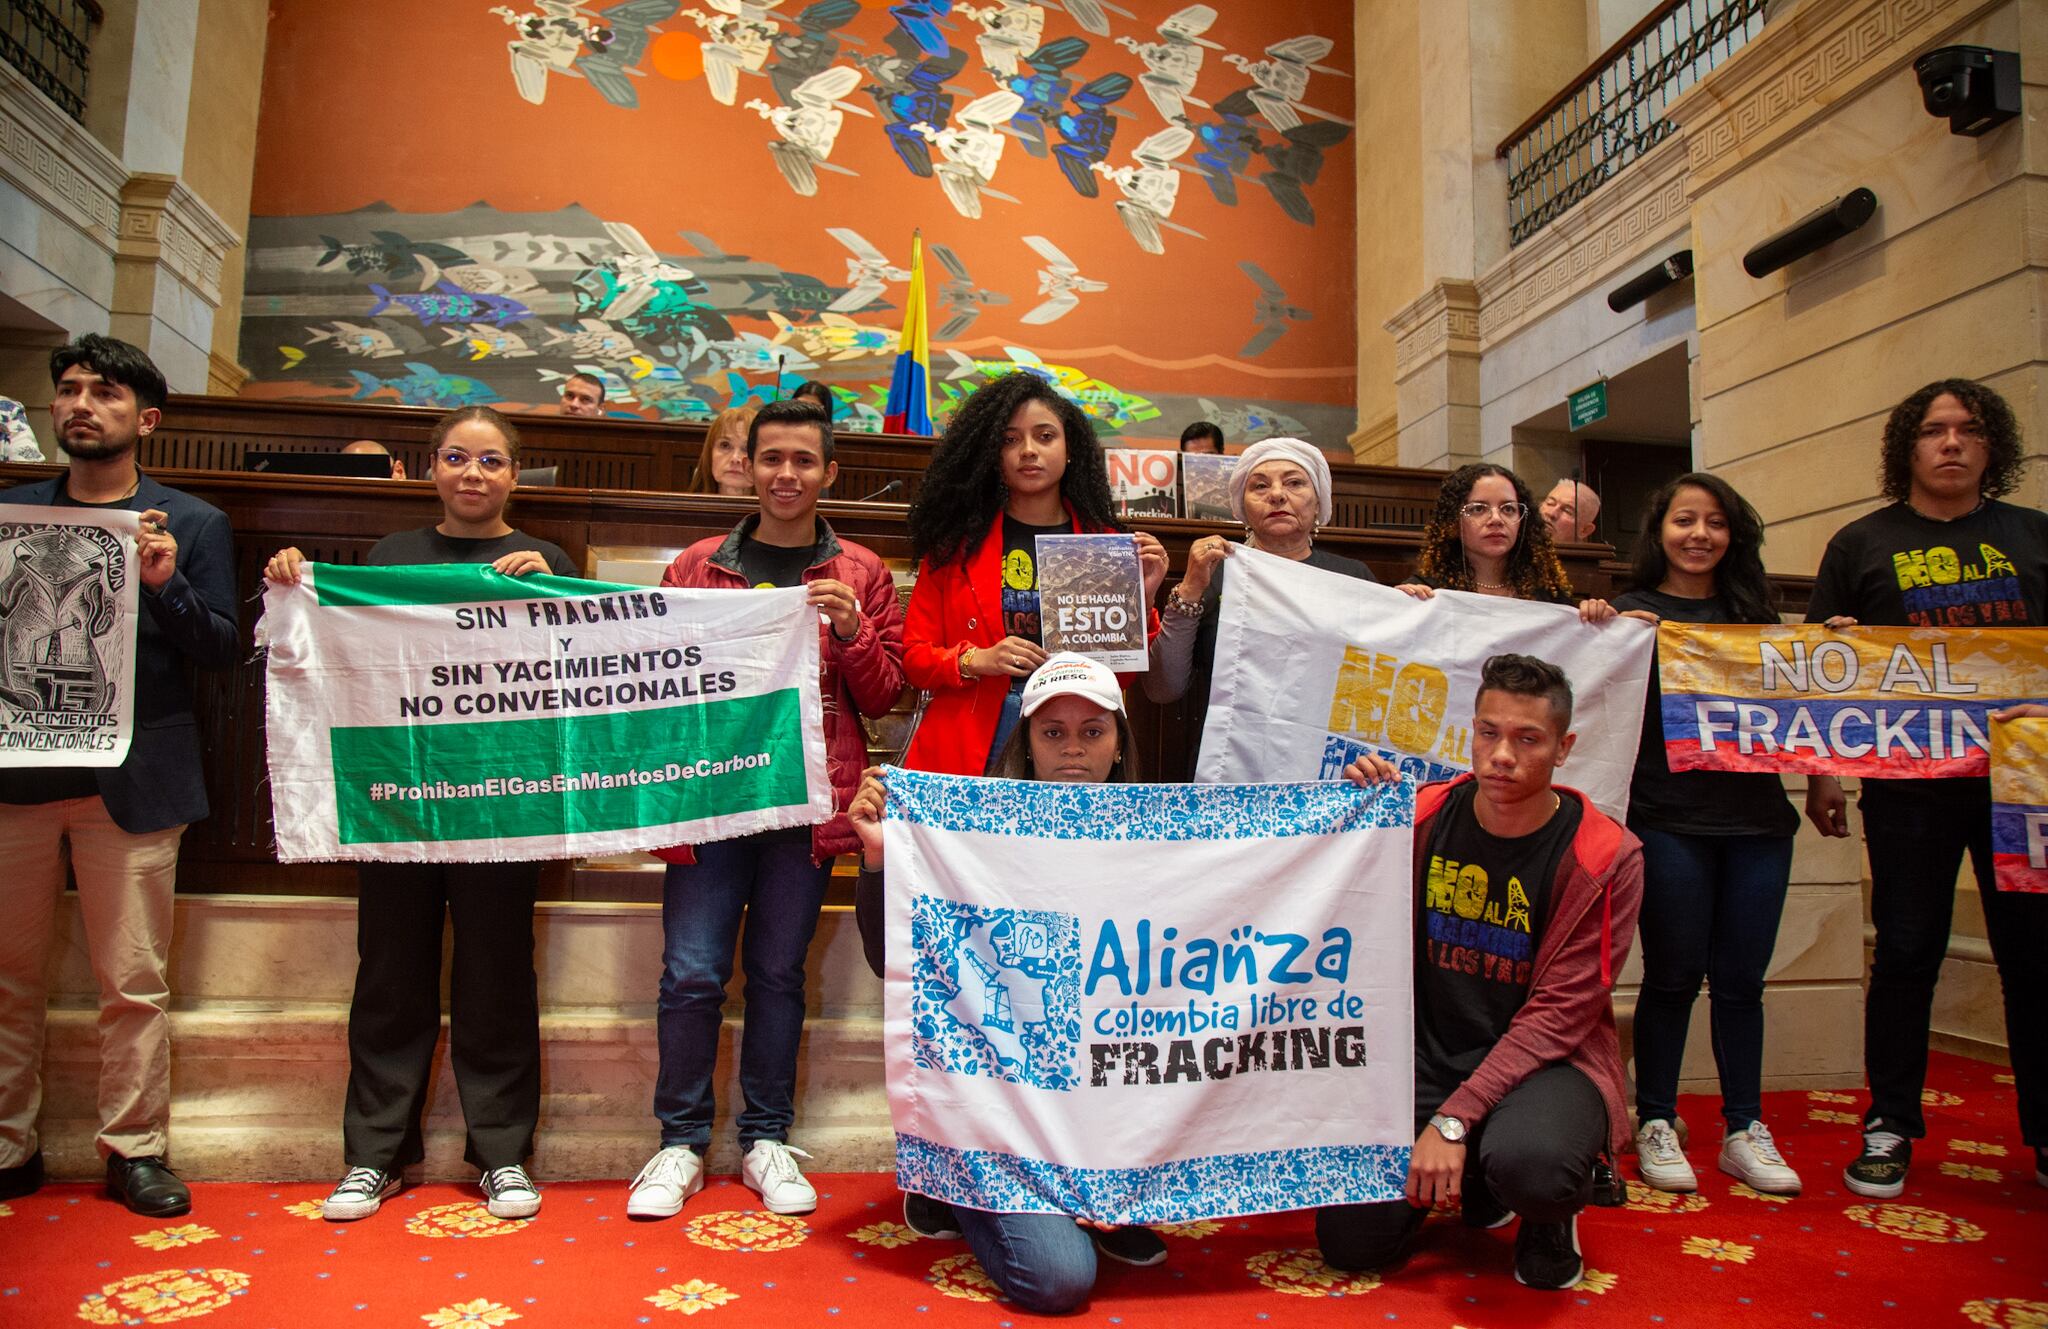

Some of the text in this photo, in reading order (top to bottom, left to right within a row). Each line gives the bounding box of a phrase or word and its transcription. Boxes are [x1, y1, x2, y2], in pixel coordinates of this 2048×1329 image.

[1109, 454, 1174, 487] NO
[1892, 546, 1960, 591] NO
[456, 592, 667, 630] SIN FRACKING
[1058, 593, 1125, 605] NO LE HAGAN
[1058, 606, 1127, 632] ESTO
[559, 638, 572, 652] Y
[1062, 633, 1127, 644] A COLOMBIA
[431, 645, 702, 687] SIN YACIMIENTOS
[1759, 641, 1978, 693] NO AL
[400, 671, 737, 718] NO CONVENCIONALES
[1328, 642, 1449, 754] NO
[1438, 724, 1471, 765] AL
[0, 731, 117, 750] CONVENCIONALES
[11, 711, 118, 726] YACIMIENTOS
[1695, 701, 1999, 760] FRACKIN
[370, 749, 771, 802] #ProhibanElGasEnMantosDeCarbon
[1426, 855, 1489, 919] NO
[1084, 919, 1352, 995] Alianza
[1094, 989, 1364, 1038] colombia libre de
[1089, 1026, 1367, 1087] FRACKING
